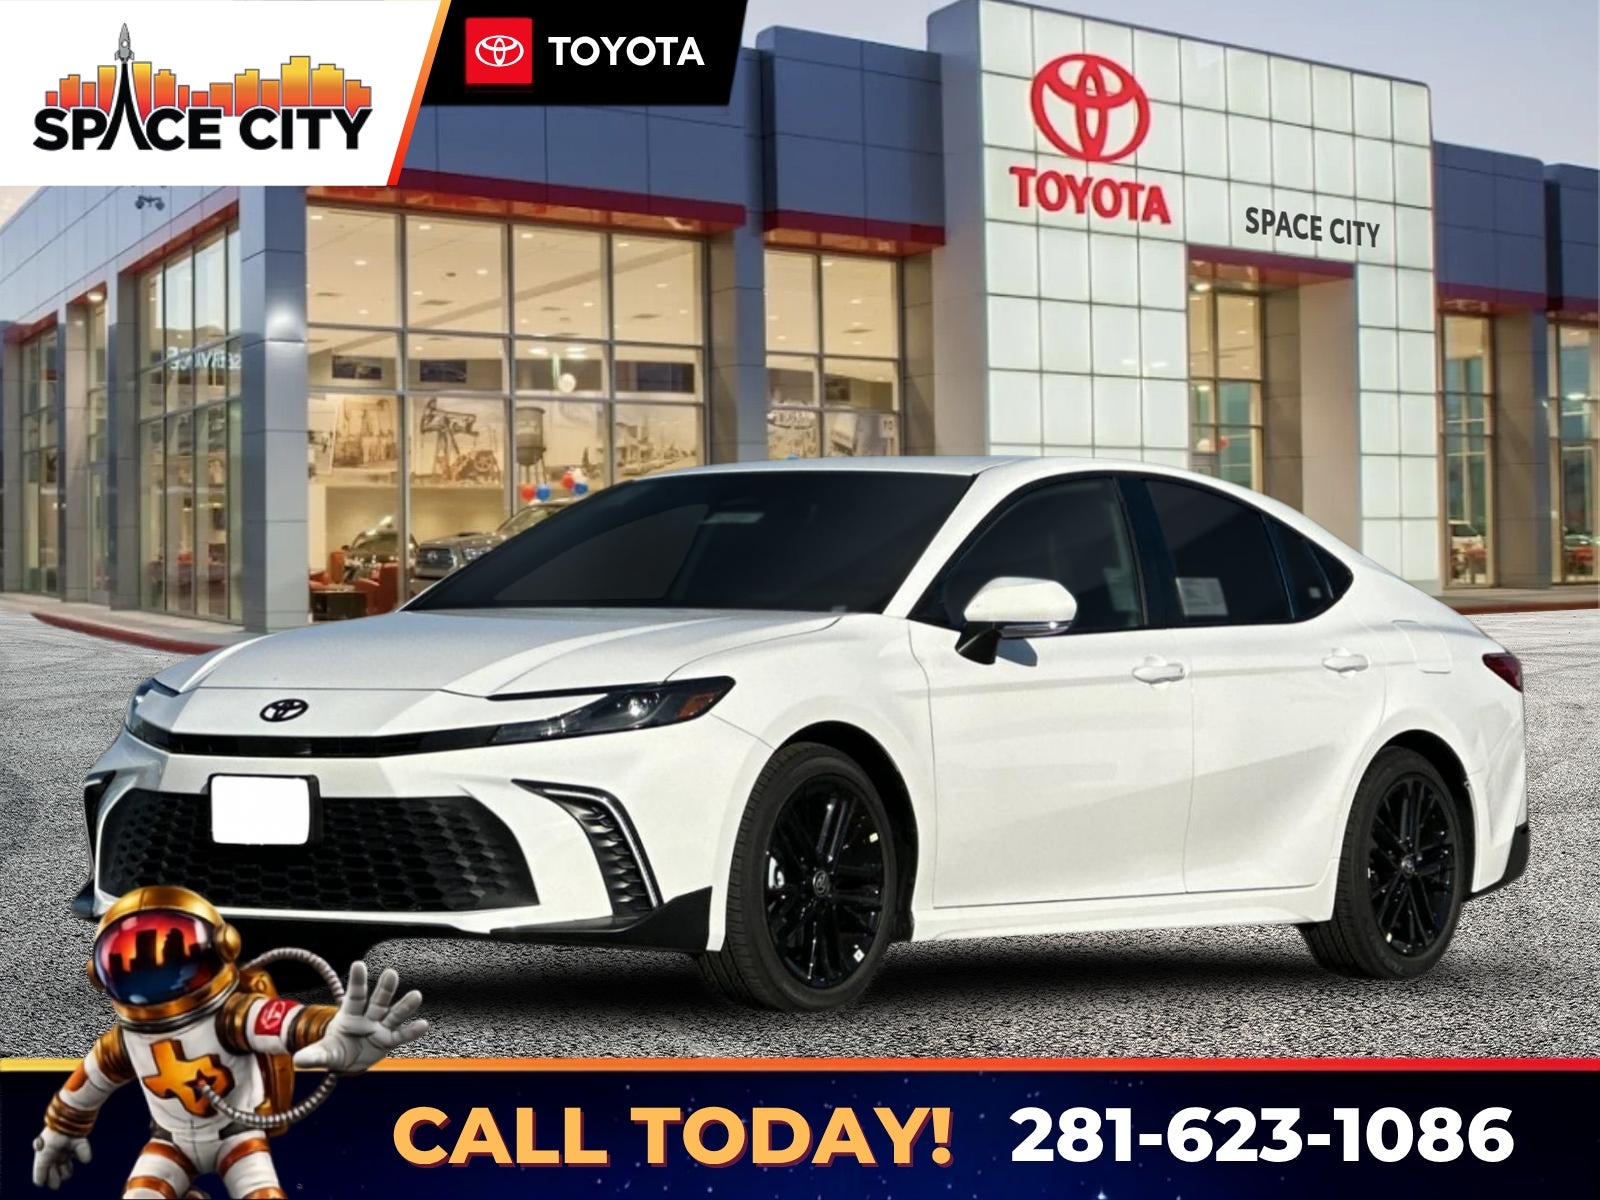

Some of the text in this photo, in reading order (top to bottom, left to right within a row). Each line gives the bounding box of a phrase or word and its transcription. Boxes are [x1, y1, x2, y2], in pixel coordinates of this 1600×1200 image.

[1009, 167, 1171, 224] TOYOTA
[1245, 207, 1380, 248] SPACE CITY
